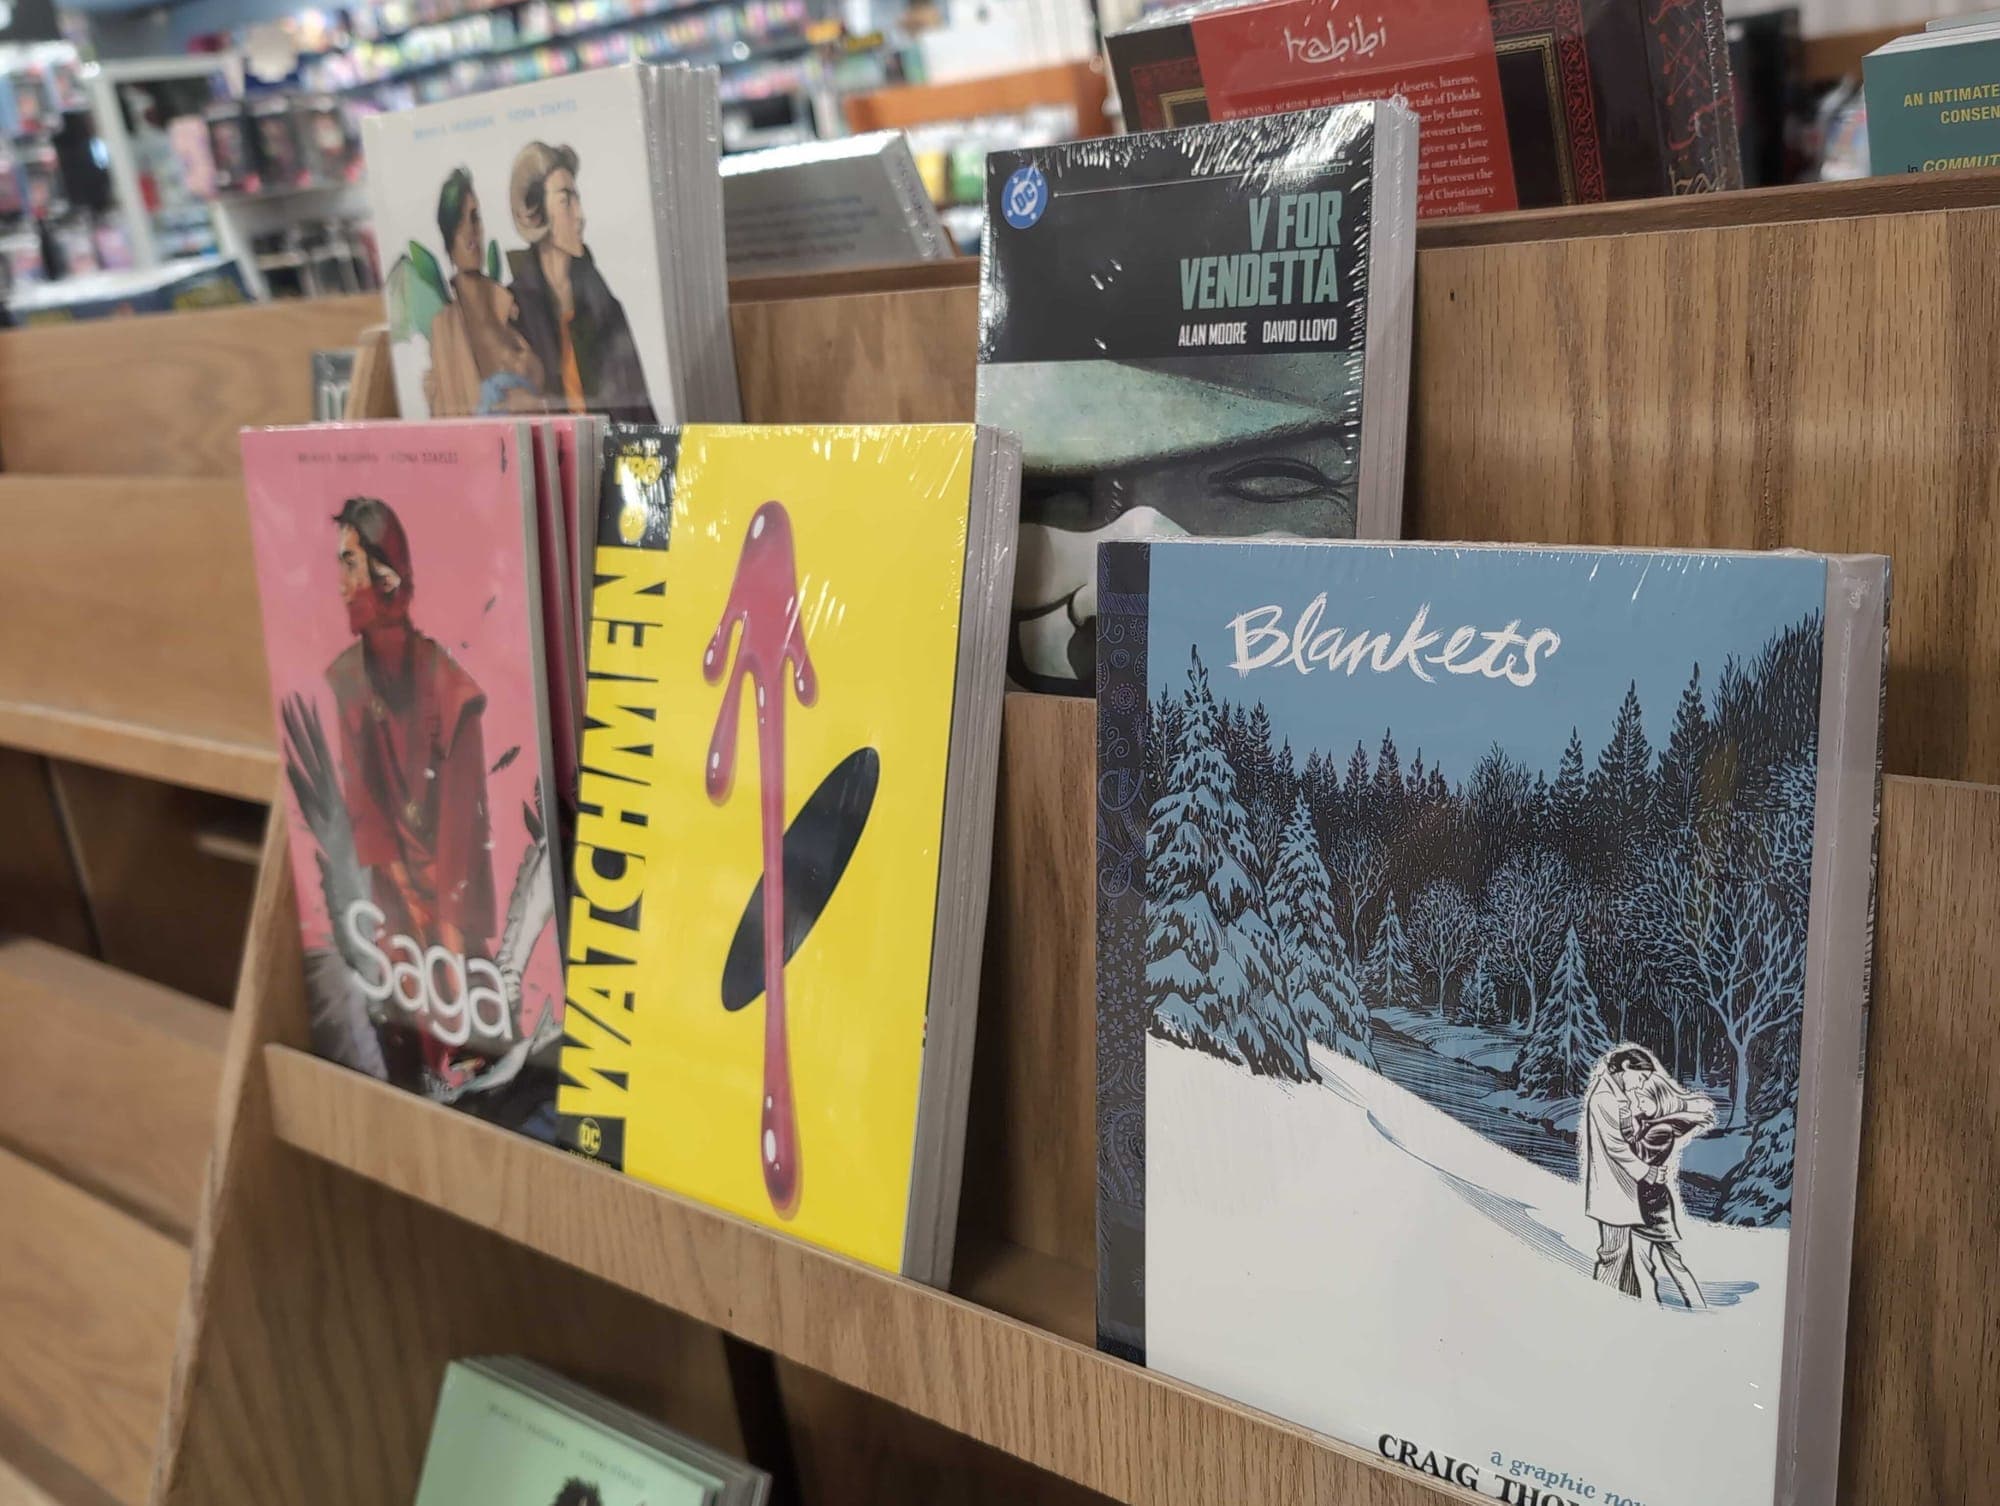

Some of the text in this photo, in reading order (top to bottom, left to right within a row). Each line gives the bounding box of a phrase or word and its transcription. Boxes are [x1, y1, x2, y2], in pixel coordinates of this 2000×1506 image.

[1904, 83, 2000, 107] AN INTIMATE
[1940, 104, 2000, 124] CONSEN
[1420, 127, 1457, 138] etween
[1923, 153, 2000, 173] COMMUT
[1249, 191, 1343, 251] V FOR
[1180, 248, 1339, 311] VENDETTA
[1178, 318, 1338, 347] ALAN MOORE DAVID LLOYD
[1225, 591, 1561, 688] Blankets
[556, 548, 668, 1118] WATCHMEN
[345, 900, 513, 1047] Saga
[578, 1119, 601, 1152] DC
[1378, 1433, 1581, 1506] CRAIG TH
[1490, 1450, 1503, 1467] a
[1508, 1459, 1596, 1499] graphic
